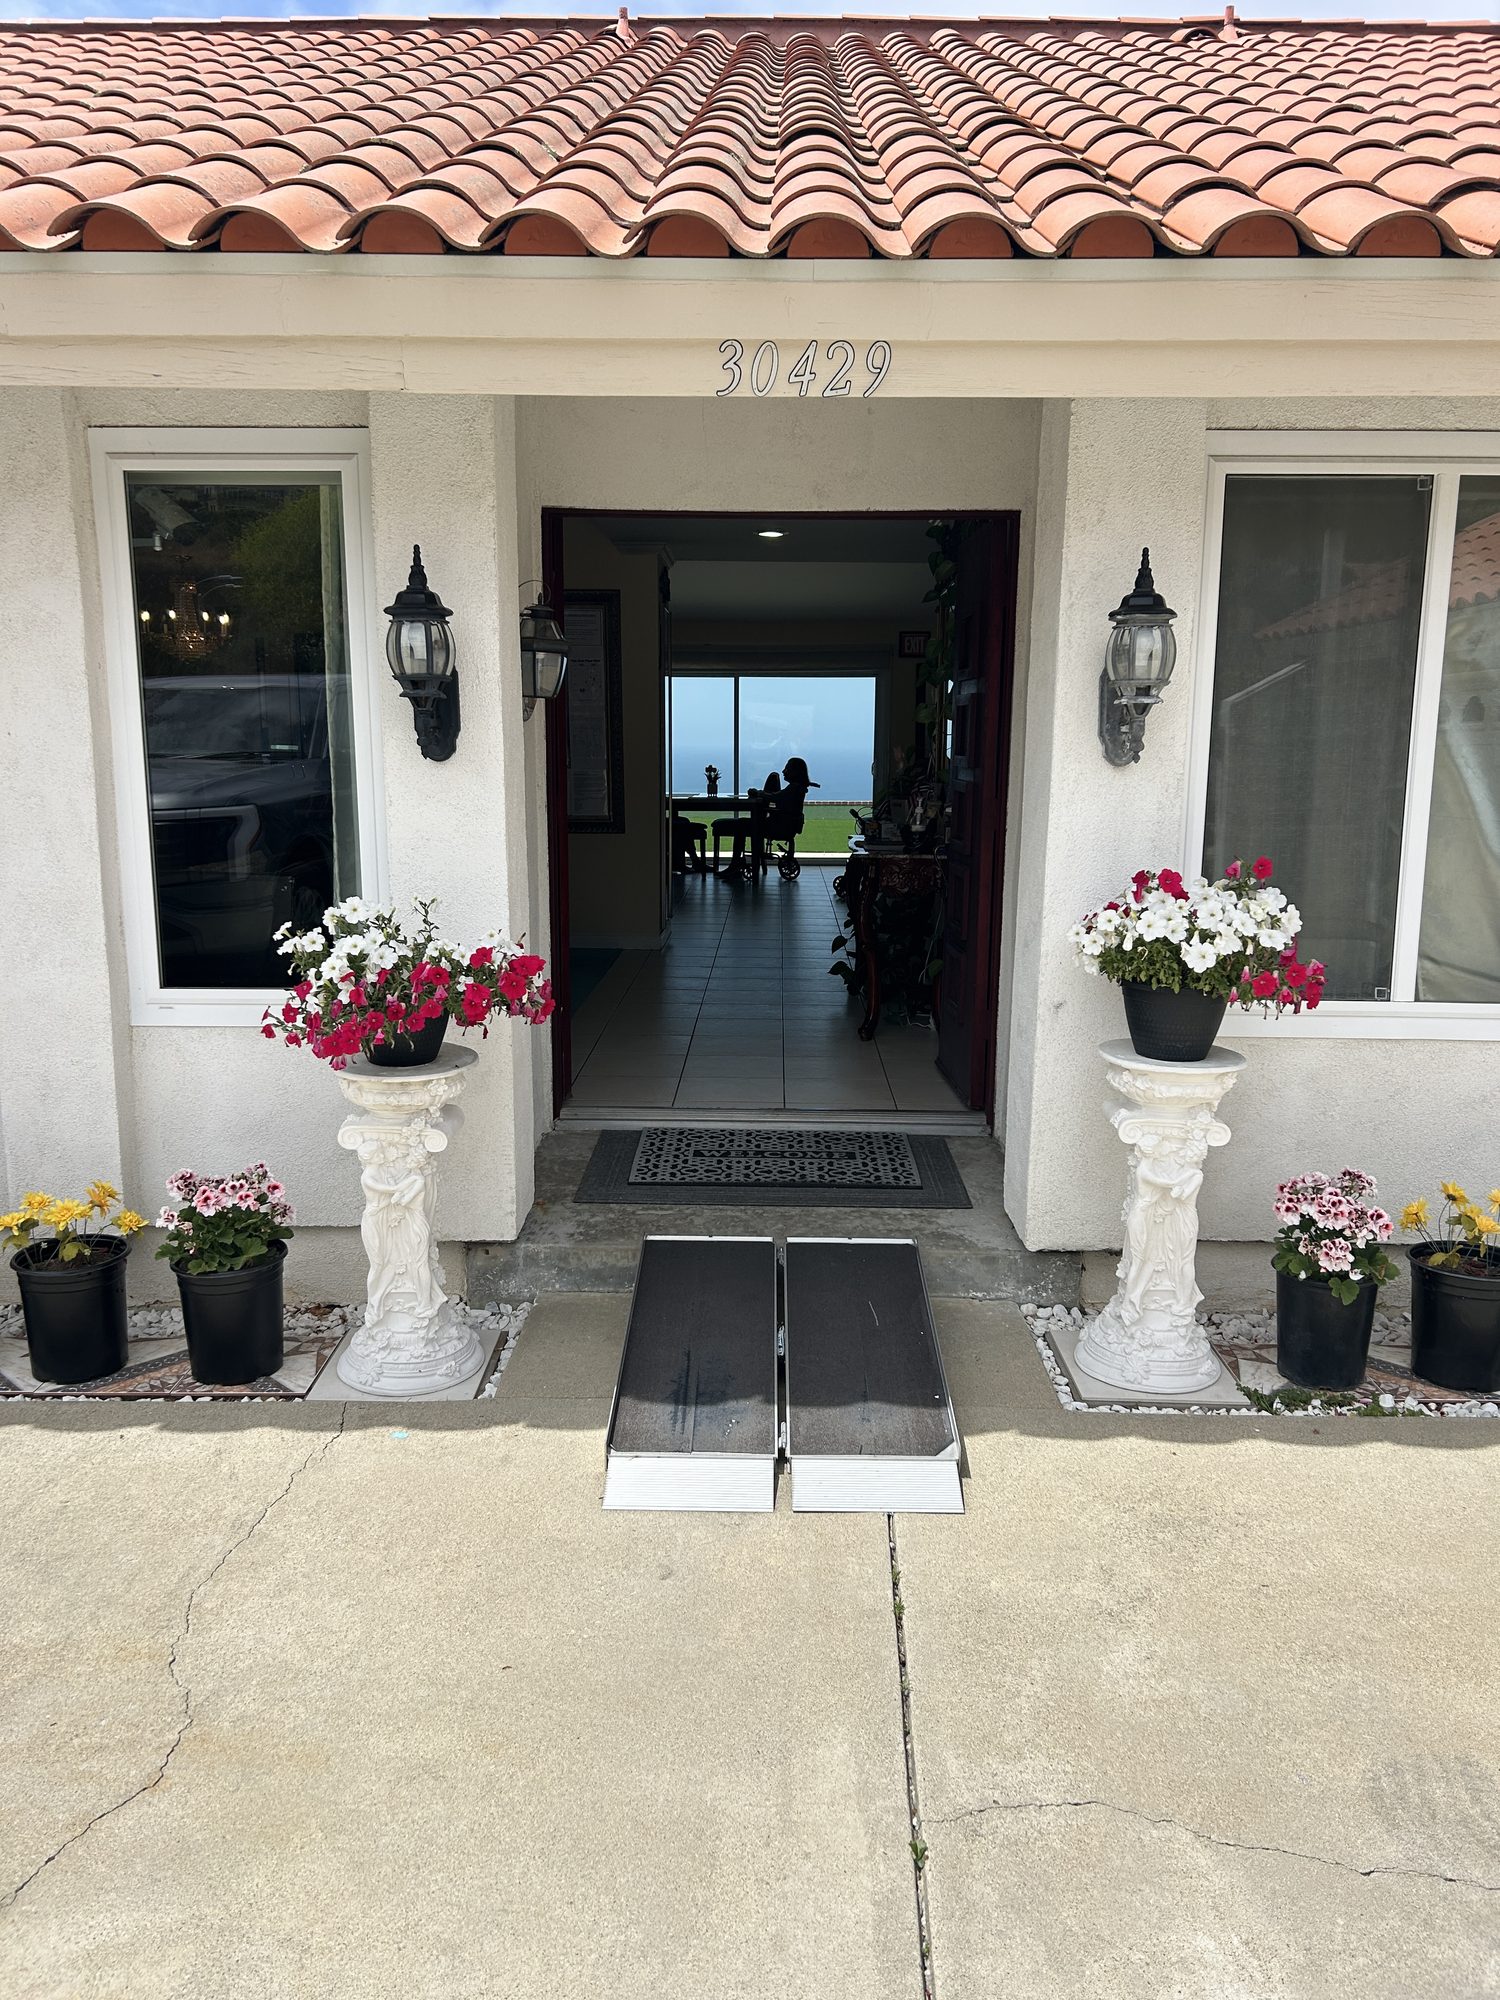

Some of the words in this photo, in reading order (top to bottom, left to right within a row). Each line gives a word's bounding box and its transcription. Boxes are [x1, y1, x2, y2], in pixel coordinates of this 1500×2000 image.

[716, 339, 892, 398] 30429
[904, 636, 924, 653] EXIT
[699, 1150, 849, 1159] WELCOME
